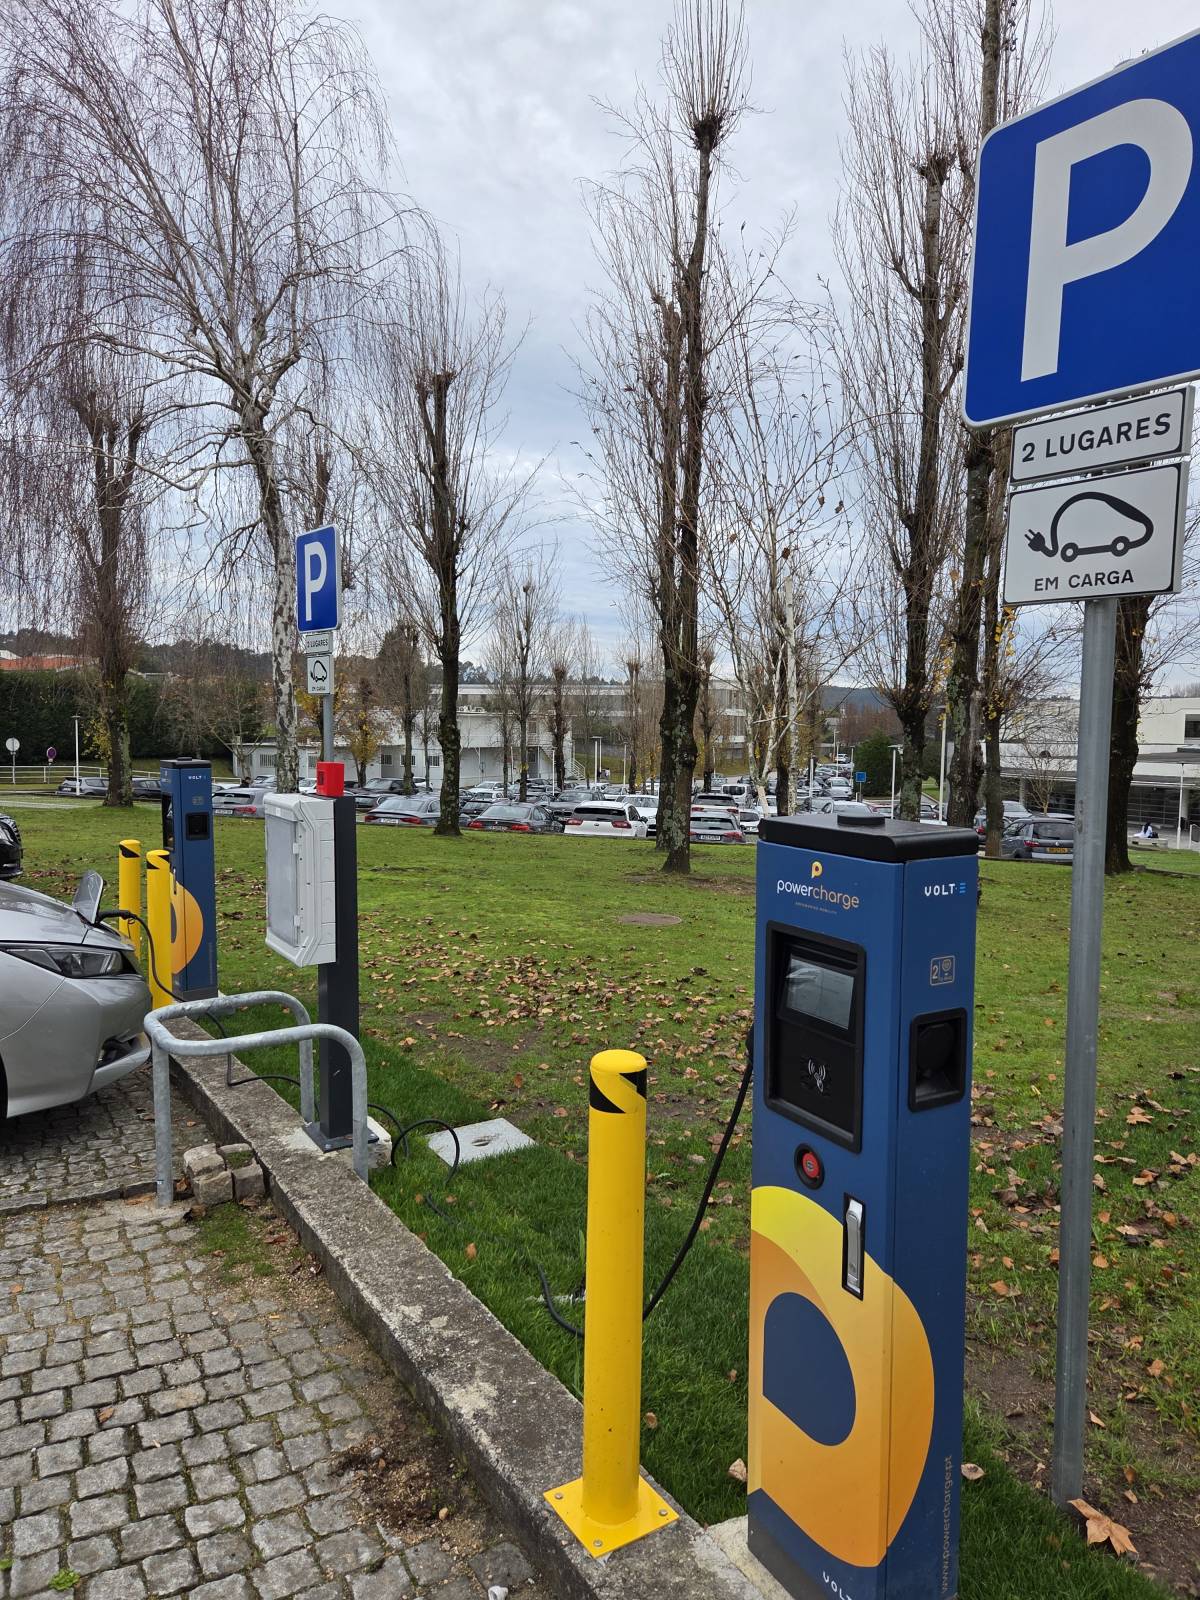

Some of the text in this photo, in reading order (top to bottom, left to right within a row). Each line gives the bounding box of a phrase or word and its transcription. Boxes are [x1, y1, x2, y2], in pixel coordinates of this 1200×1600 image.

[1021, 98, 1193, 382] P
[1022, 413, 1171, 463] 2 LUGARES
[304, 541, 327, 622] P
[1034, 570, 1134, 591] EM CARGA
[777, 879, 860, 910] powercharge
[932, 964, 939, 979] 2
[941, 1455, 953, 1594] www.powercharge.pt
